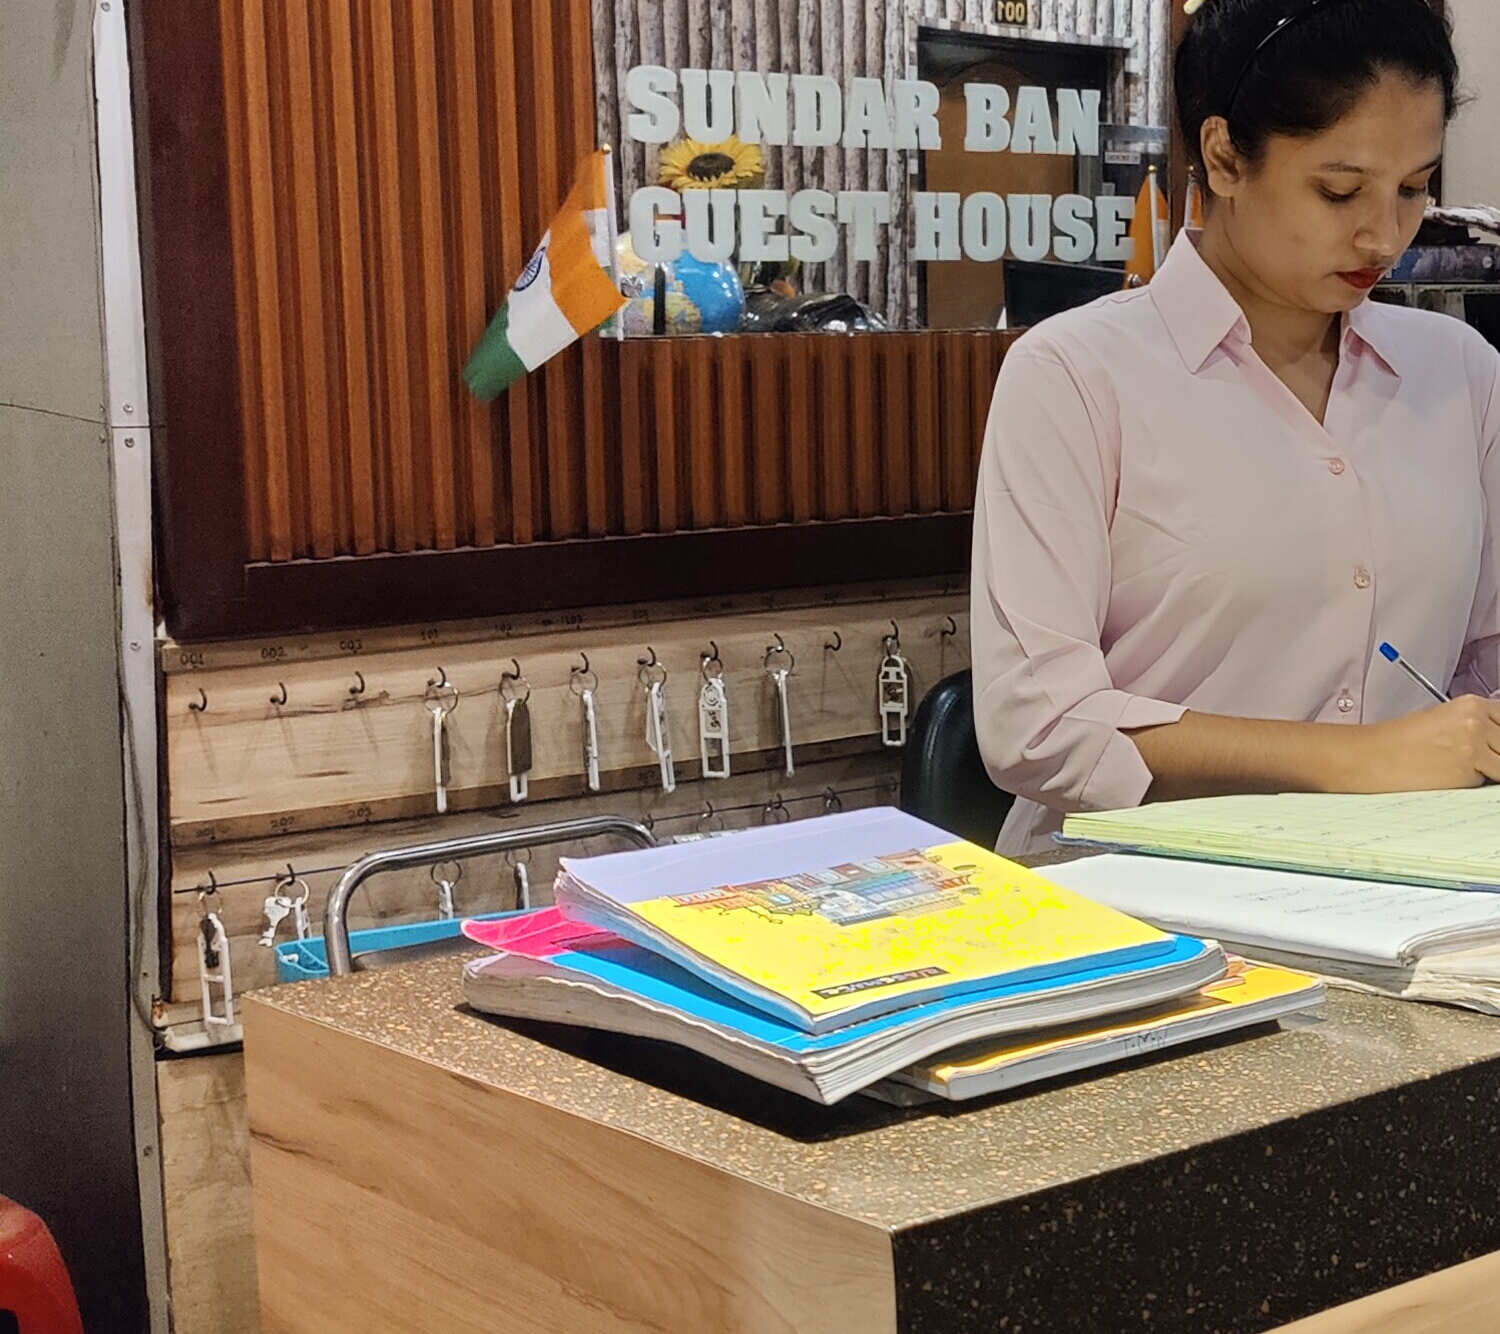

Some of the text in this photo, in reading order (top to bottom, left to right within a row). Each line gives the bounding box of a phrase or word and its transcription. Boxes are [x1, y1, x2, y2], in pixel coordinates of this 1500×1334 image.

[626, 65, 1100, 156] SUNDAR BAN
[629, 186, 1135, 263] GUEST HOUSE
[180, 653, 204, 666] 001
[260, 647, 287, 659] 002
